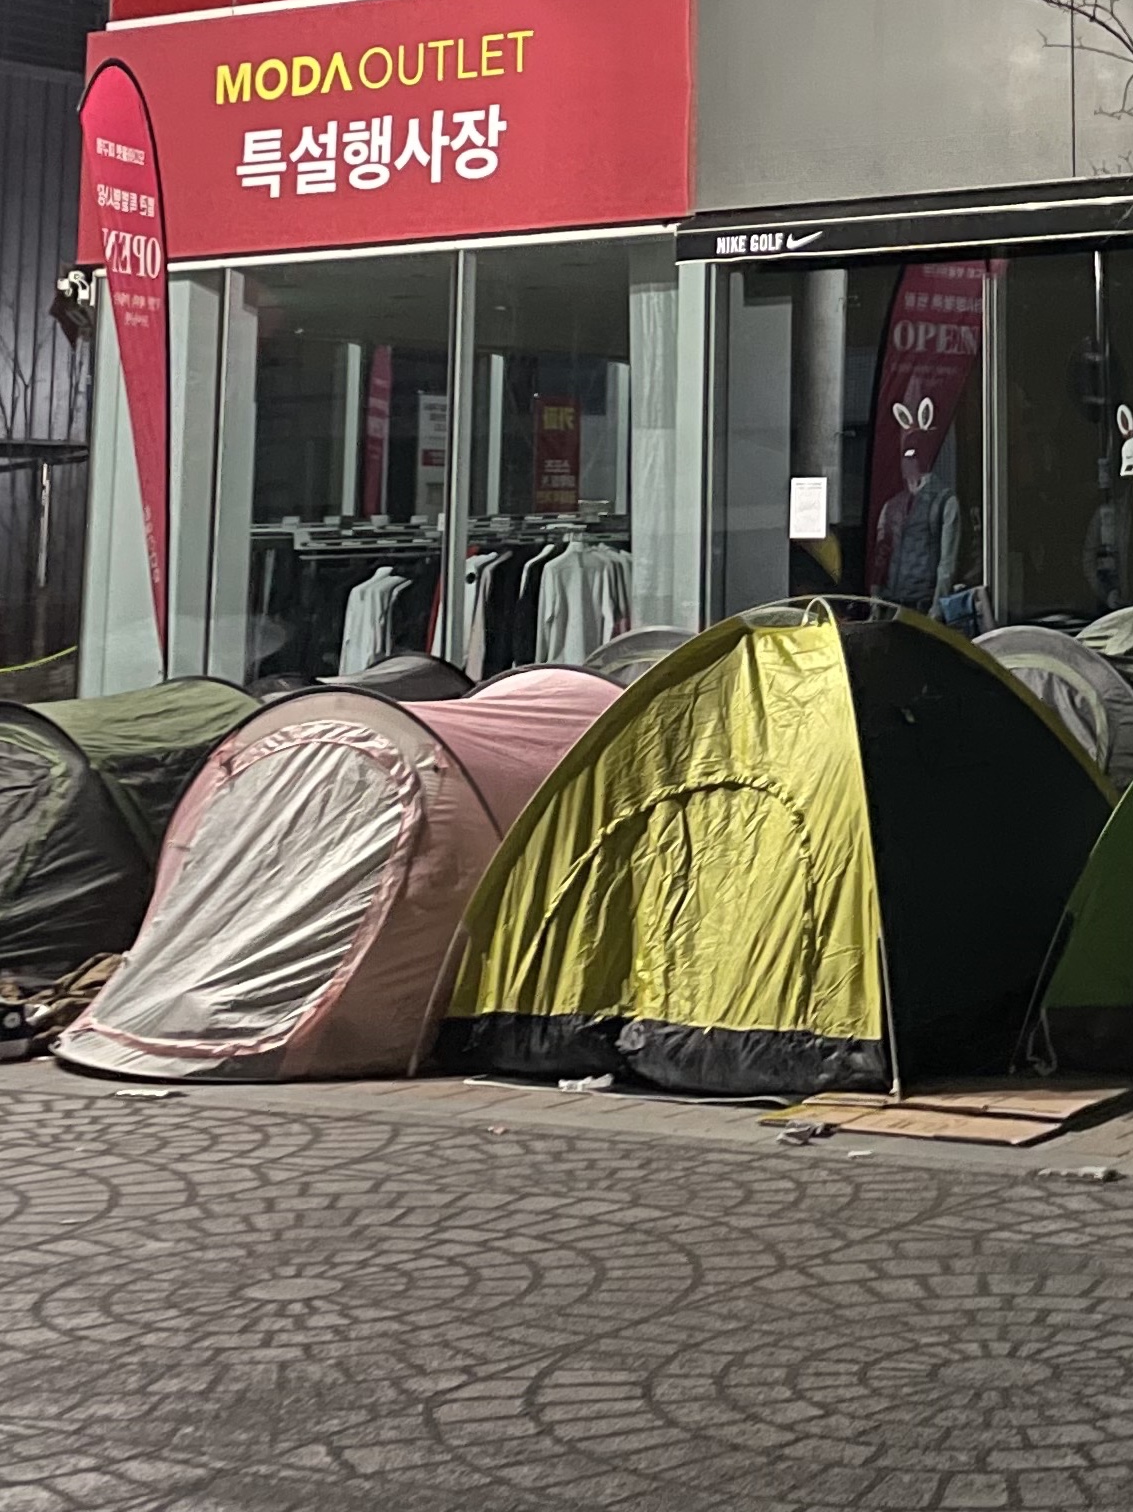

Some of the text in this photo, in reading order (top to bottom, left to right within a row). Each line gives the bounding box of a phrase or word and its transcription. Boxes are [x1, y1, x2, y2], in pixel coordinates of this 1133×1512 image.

[214, 30, 535, 106] MODA OUTLET
[235, 103, 508, 198] 특설행사장
[716, 232, 784, 255] NIKE GOLF
[893, 319, 979, 356] OPEN
